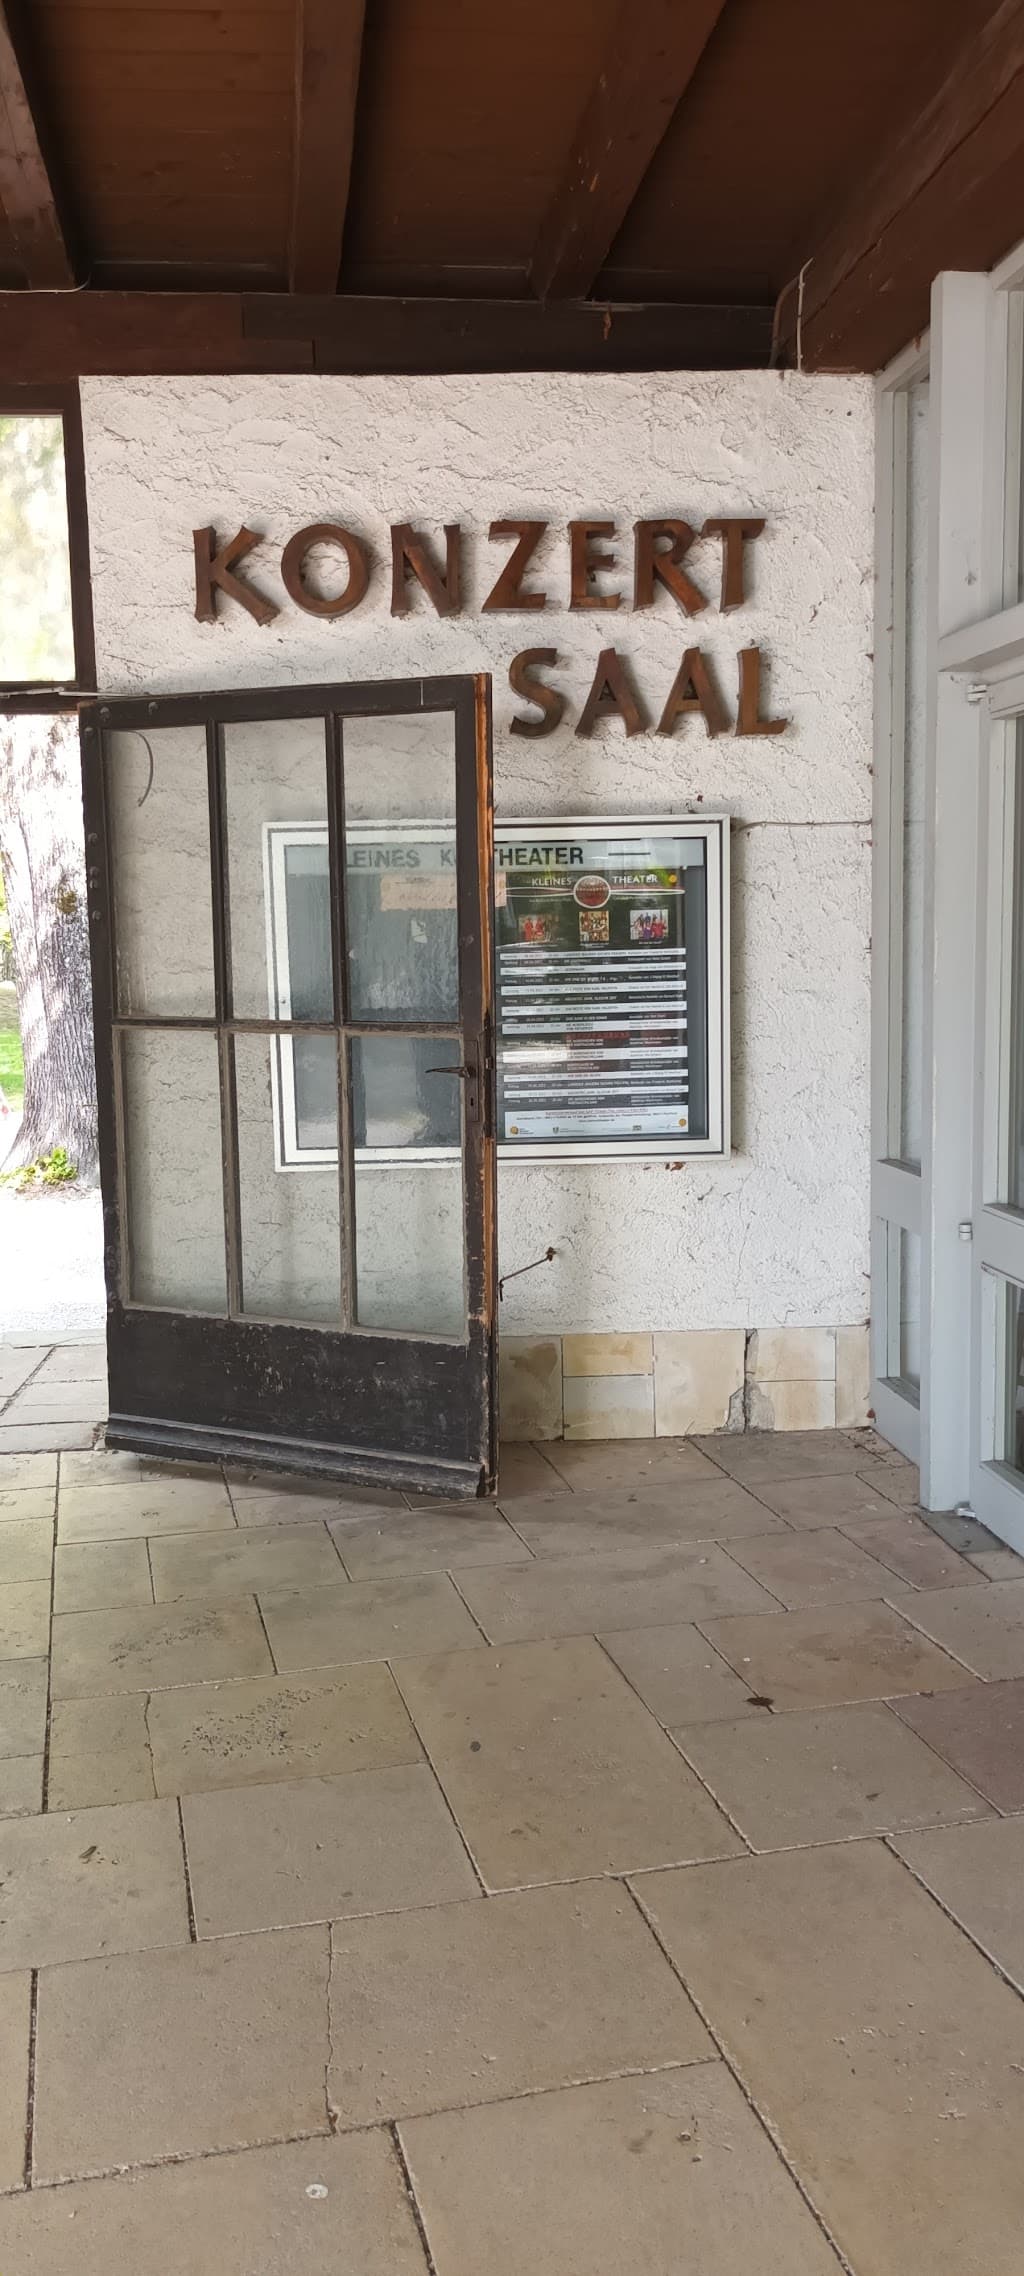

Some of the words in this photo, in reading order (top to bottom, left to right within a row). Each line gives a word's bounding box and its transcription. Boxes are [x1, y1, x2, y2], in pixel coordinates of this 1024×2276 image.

[193, 518, 766, 627] KONZERT
[508, 646, 788, 739] SAAL
[532, 877, 572, 887] KLEINES
[612, 874, 659, 885] THEATER
